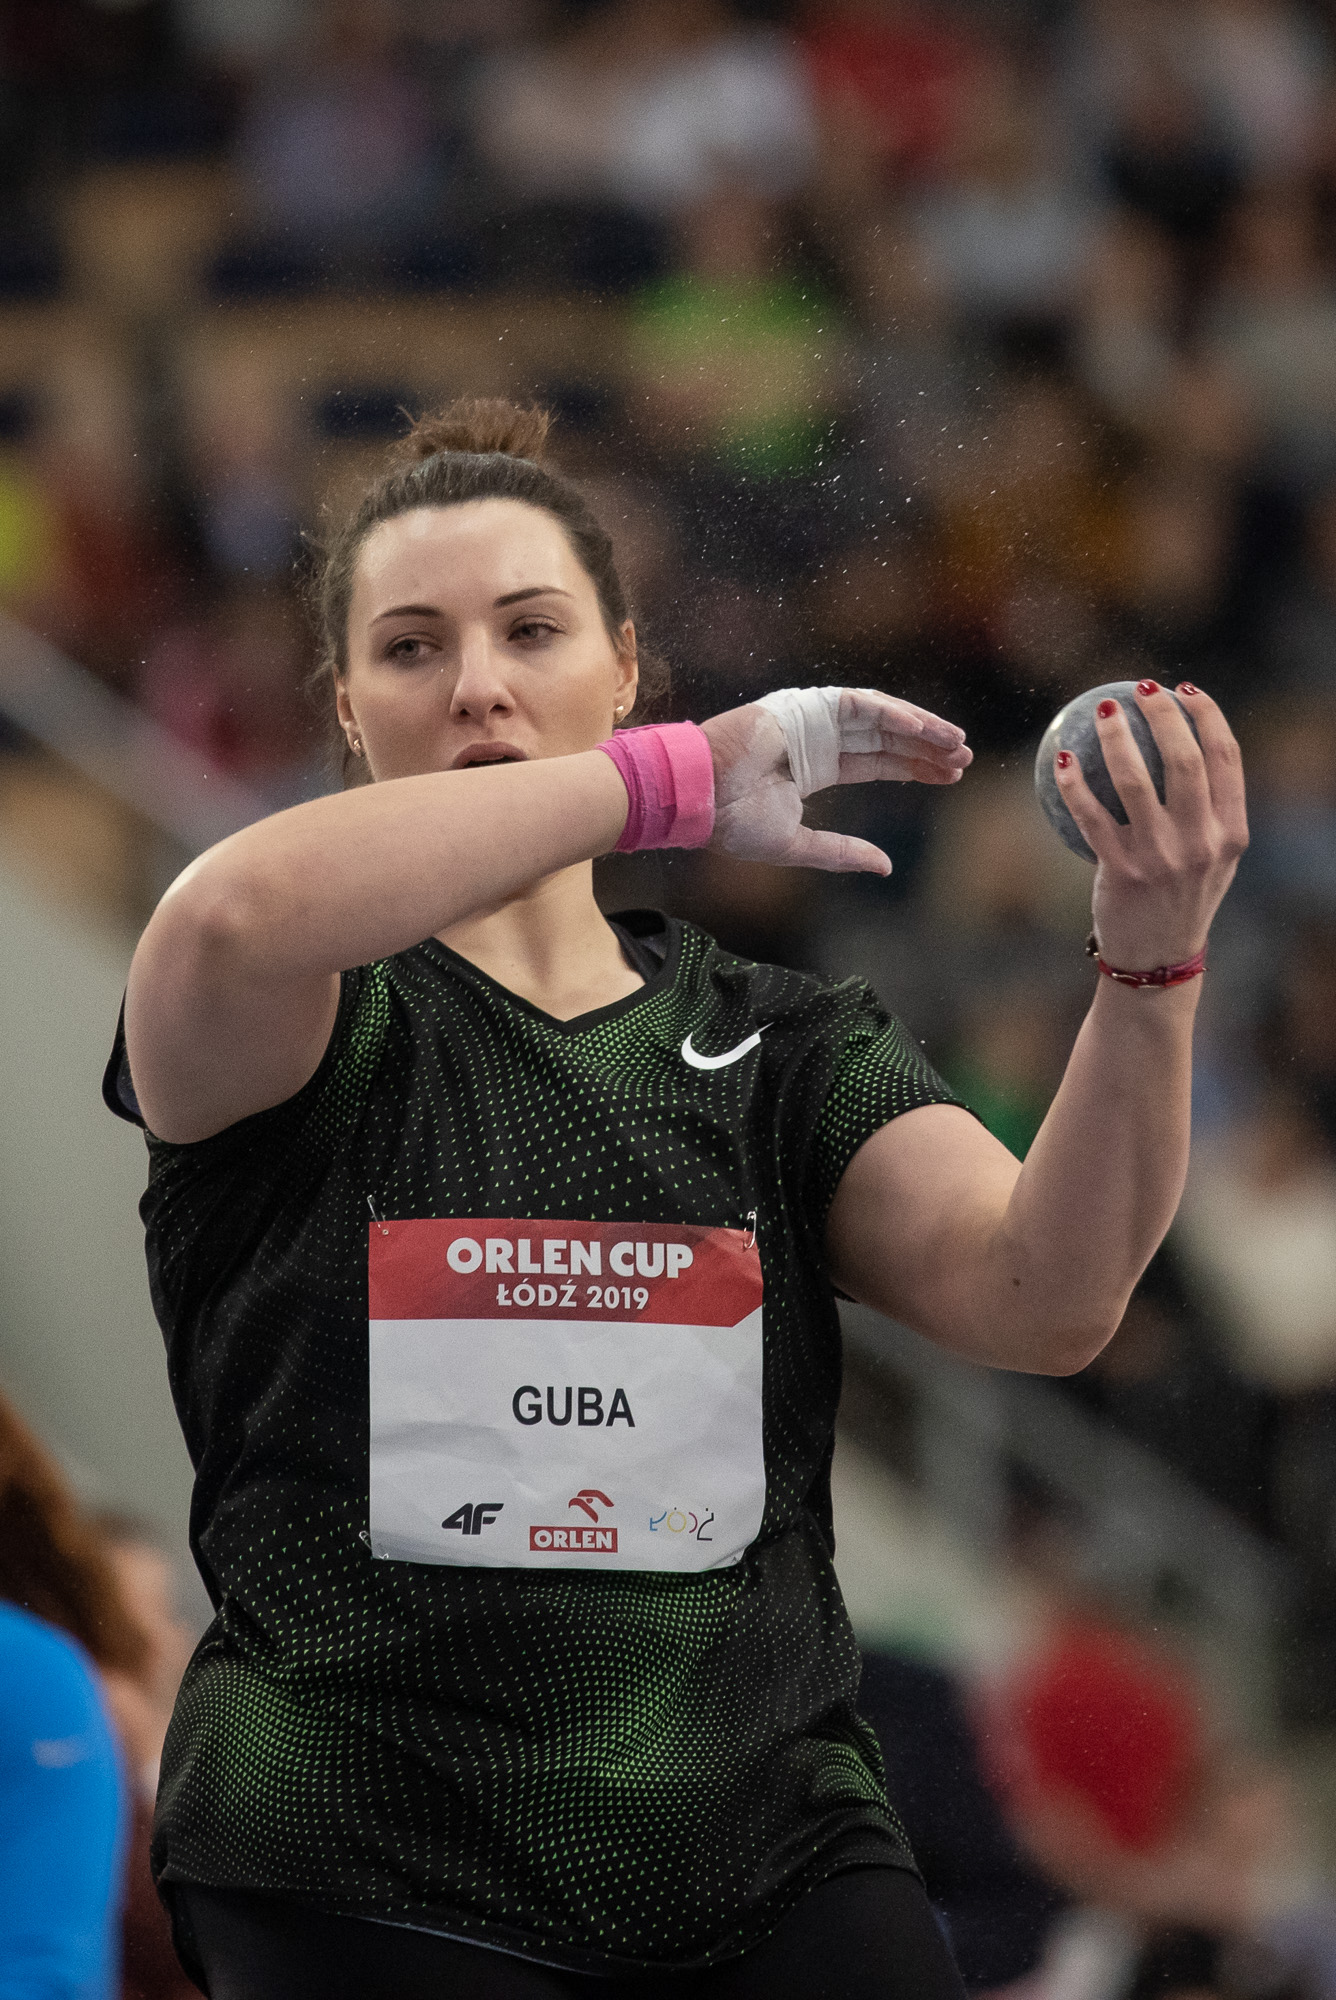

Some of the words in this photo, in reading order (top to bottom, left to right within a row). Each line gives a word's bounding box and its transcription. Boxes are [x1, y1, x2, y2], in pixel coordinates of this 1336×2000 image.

[446, 1237, 602, 1276] ORLEN
[608, 1241, 693, 1279] CUP
[496, 1278, 578, 1308] ŁÓDŹ
[586, 1285, 649, 1310] 2019
[512, 1385, 636, 1428] GUBA
[441, 1502, 504, 1535] 4F
[533, 1529, 613, 1550] ORLEN
